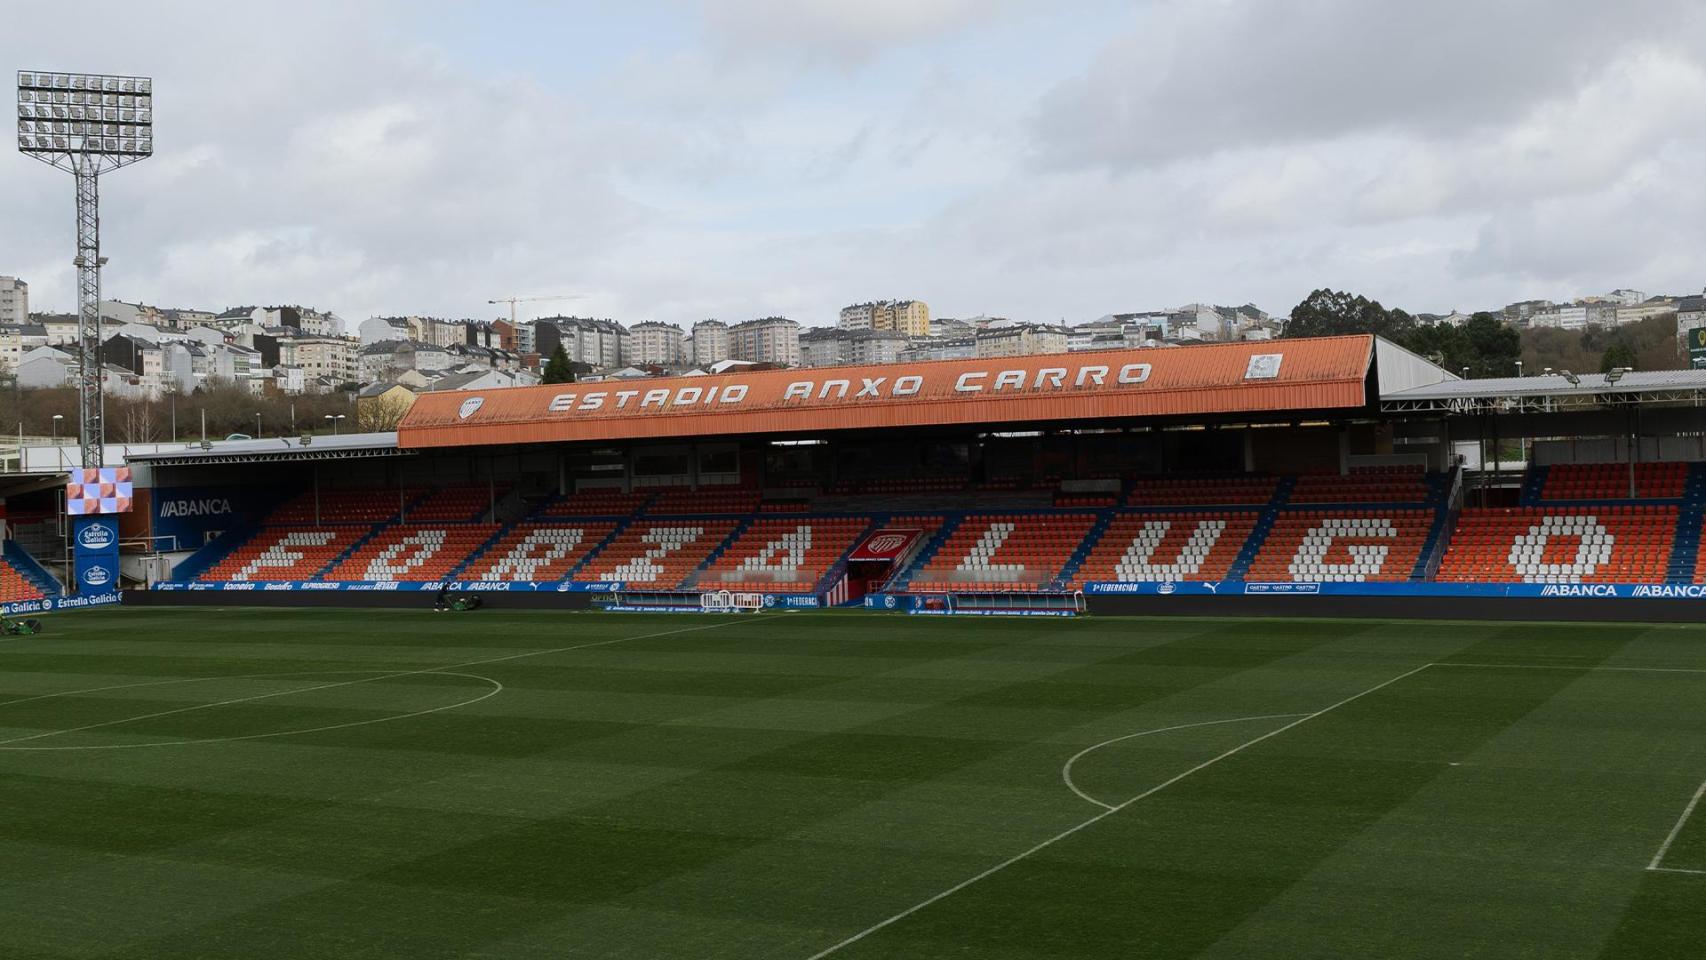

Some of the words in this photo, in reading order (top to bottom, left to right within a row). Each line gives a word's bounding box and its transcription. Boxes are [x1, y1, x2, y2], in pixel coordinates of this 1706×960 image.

[549, 384, 749, 412] ESTADIO
[783, 375, 924, 400] ANXO
[955, 363, 1152, 393] CARRO
[11, 602, 41, 613] Galicia
[57, 596, 89, 608] Estrella
[88, 592, 118, 604] Galicia
